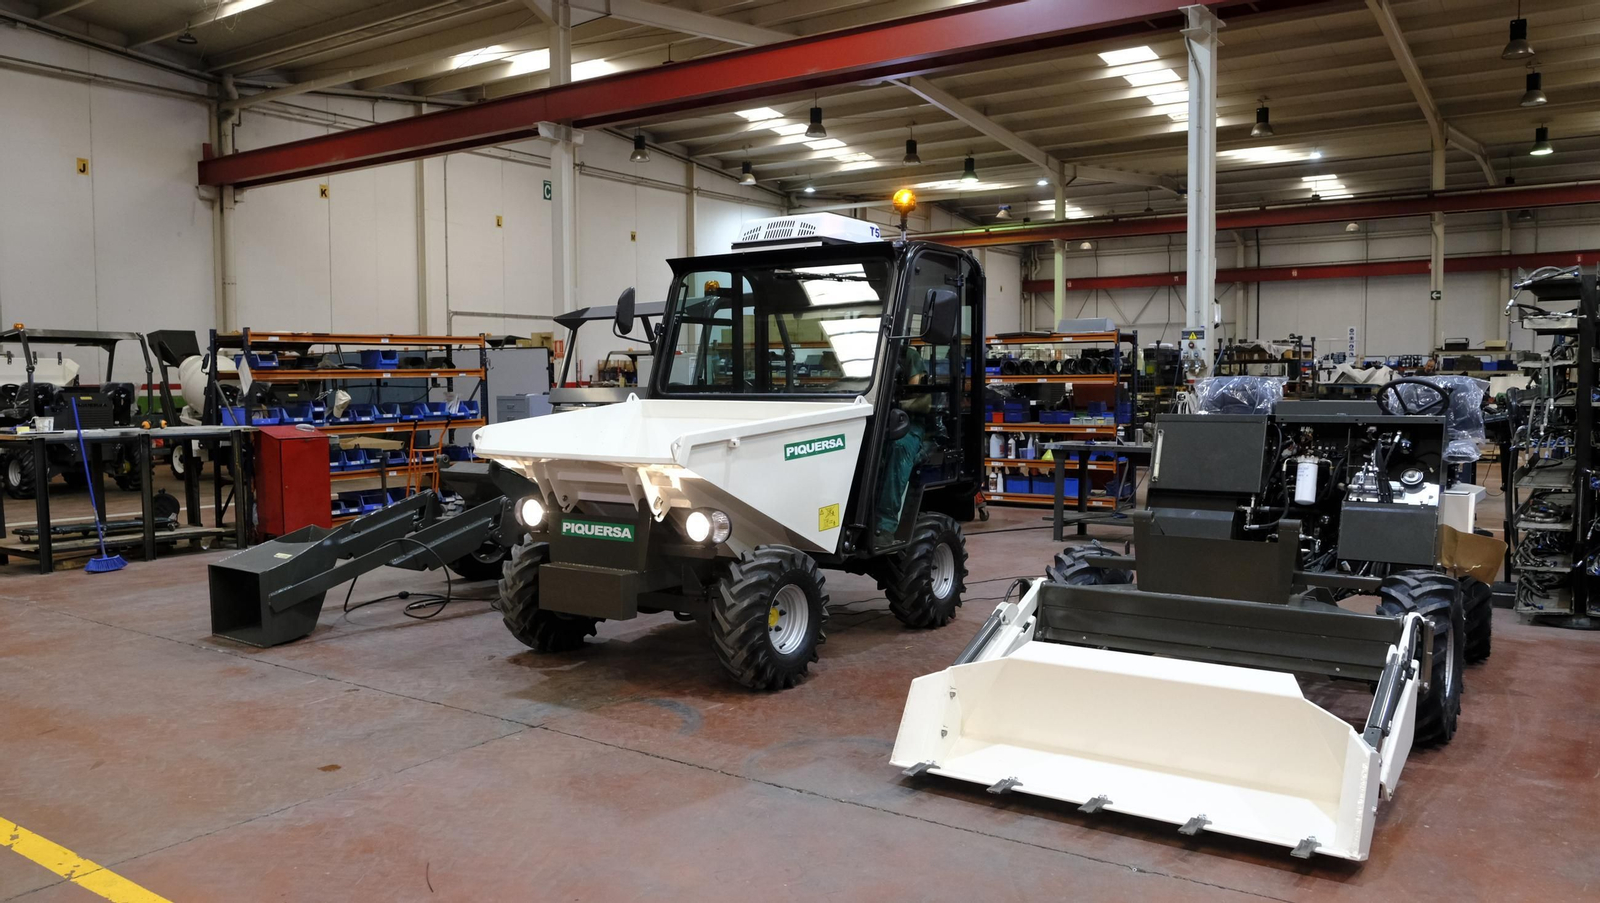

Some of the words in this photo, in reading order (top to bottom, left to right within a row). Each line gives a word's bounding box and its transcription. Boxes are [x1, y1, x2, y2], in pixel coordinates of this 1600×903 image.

[79, 163, 86, 173] J
[320, 188, 327, 198] K
[545, 185, 551, 199] C
[497, 219, 501, 227] L
[786, 438, 845, 457] PIQUERSA
[562, 522, 632, 539] PIQUERSA
